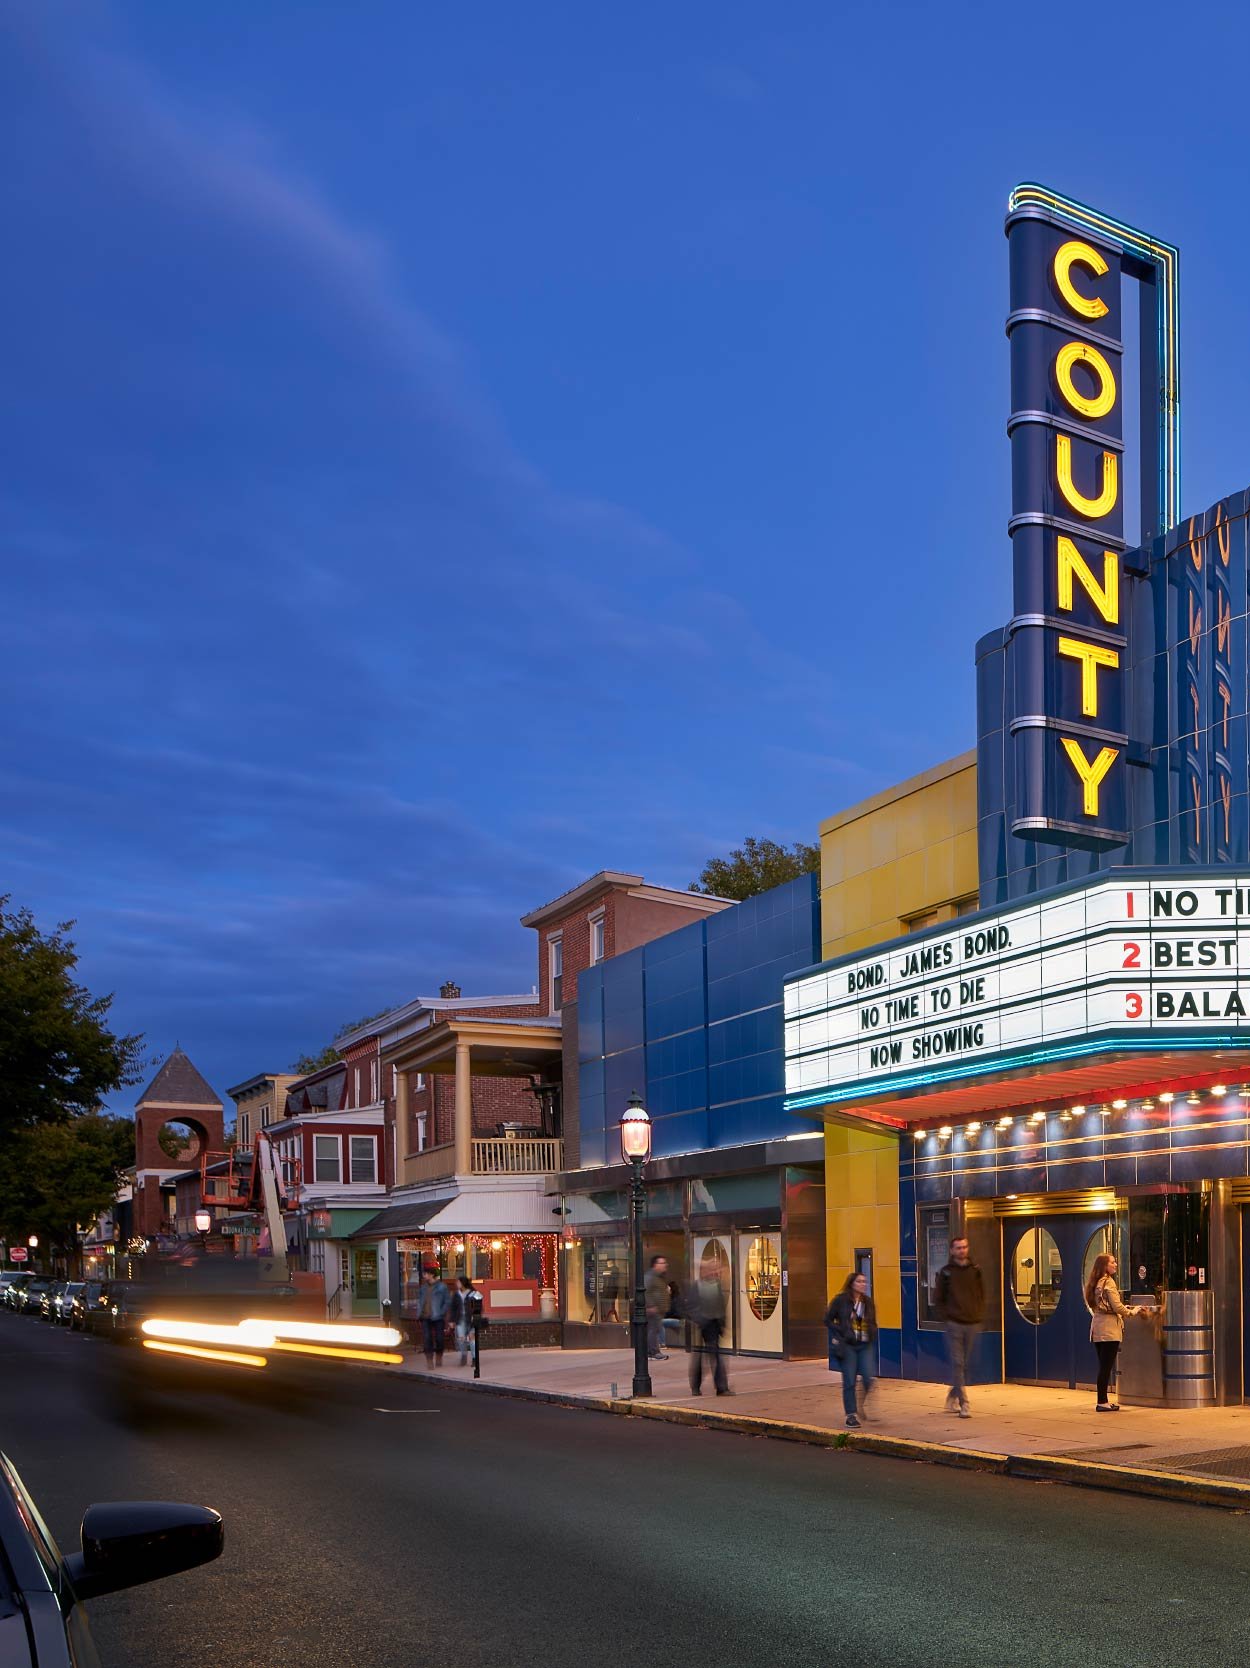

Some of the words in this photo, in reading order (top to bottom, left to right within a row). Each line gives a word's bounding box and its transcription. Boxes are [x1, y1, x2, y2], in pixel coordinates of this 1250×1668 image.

[1054, 240, 1119, 817] COUNTY
[1126, 892, 1134, 918] 1
[1153, 890, 1198, 917] NO
[848, 964, 887, 993] BOND.
[900, 943, 952, 977] JAMES
[964, 926, 1012, 959] BOND.
[1122, 942, 1141, 968] 2
[1155, 939, 1236, 967] BEST
[861, 1004, 880, 1029] NO
[885, 995, 919, 1023] TIME
[931, 987, 951, 1012] TO
[960, 977, 985, 1004] DIE
[1125, 992, 1142, 1018] 3
[870, 1041, 902, 1068] NOW
[912, 1024, 984, 1060] SHOWING
